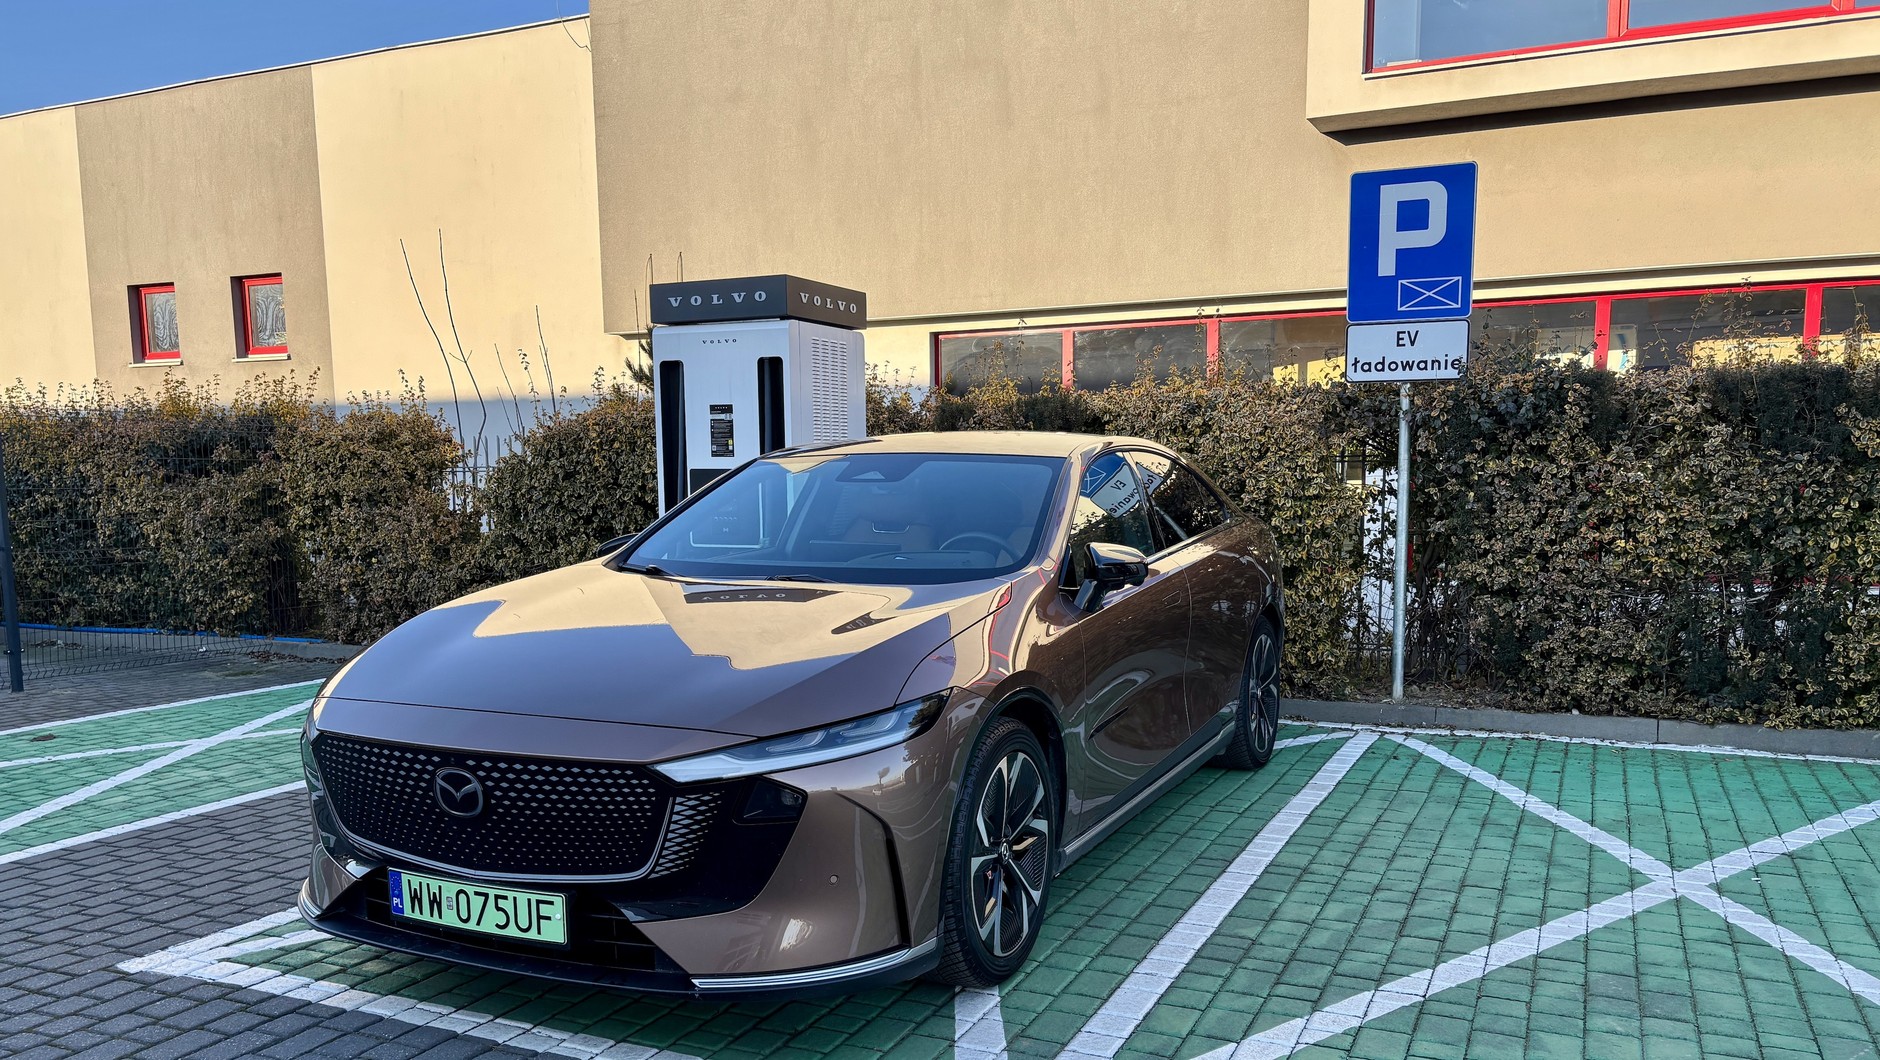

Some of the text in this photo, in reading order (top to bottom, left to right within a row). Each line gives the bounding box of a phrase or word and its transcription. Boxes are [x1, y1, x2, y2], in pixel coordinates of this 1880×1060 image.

[1378, 181, 1448, 277] P
[668, 291, 767, 308] VOLVO
[800, 292, 857, 314] VOLVO
[1396, 330, 1420, 347] EV
[1352, 354, 1462, 374] ładowanie
[392, 897, 403, 909] PL
[407, 879, 555, 936] WW 075UF
